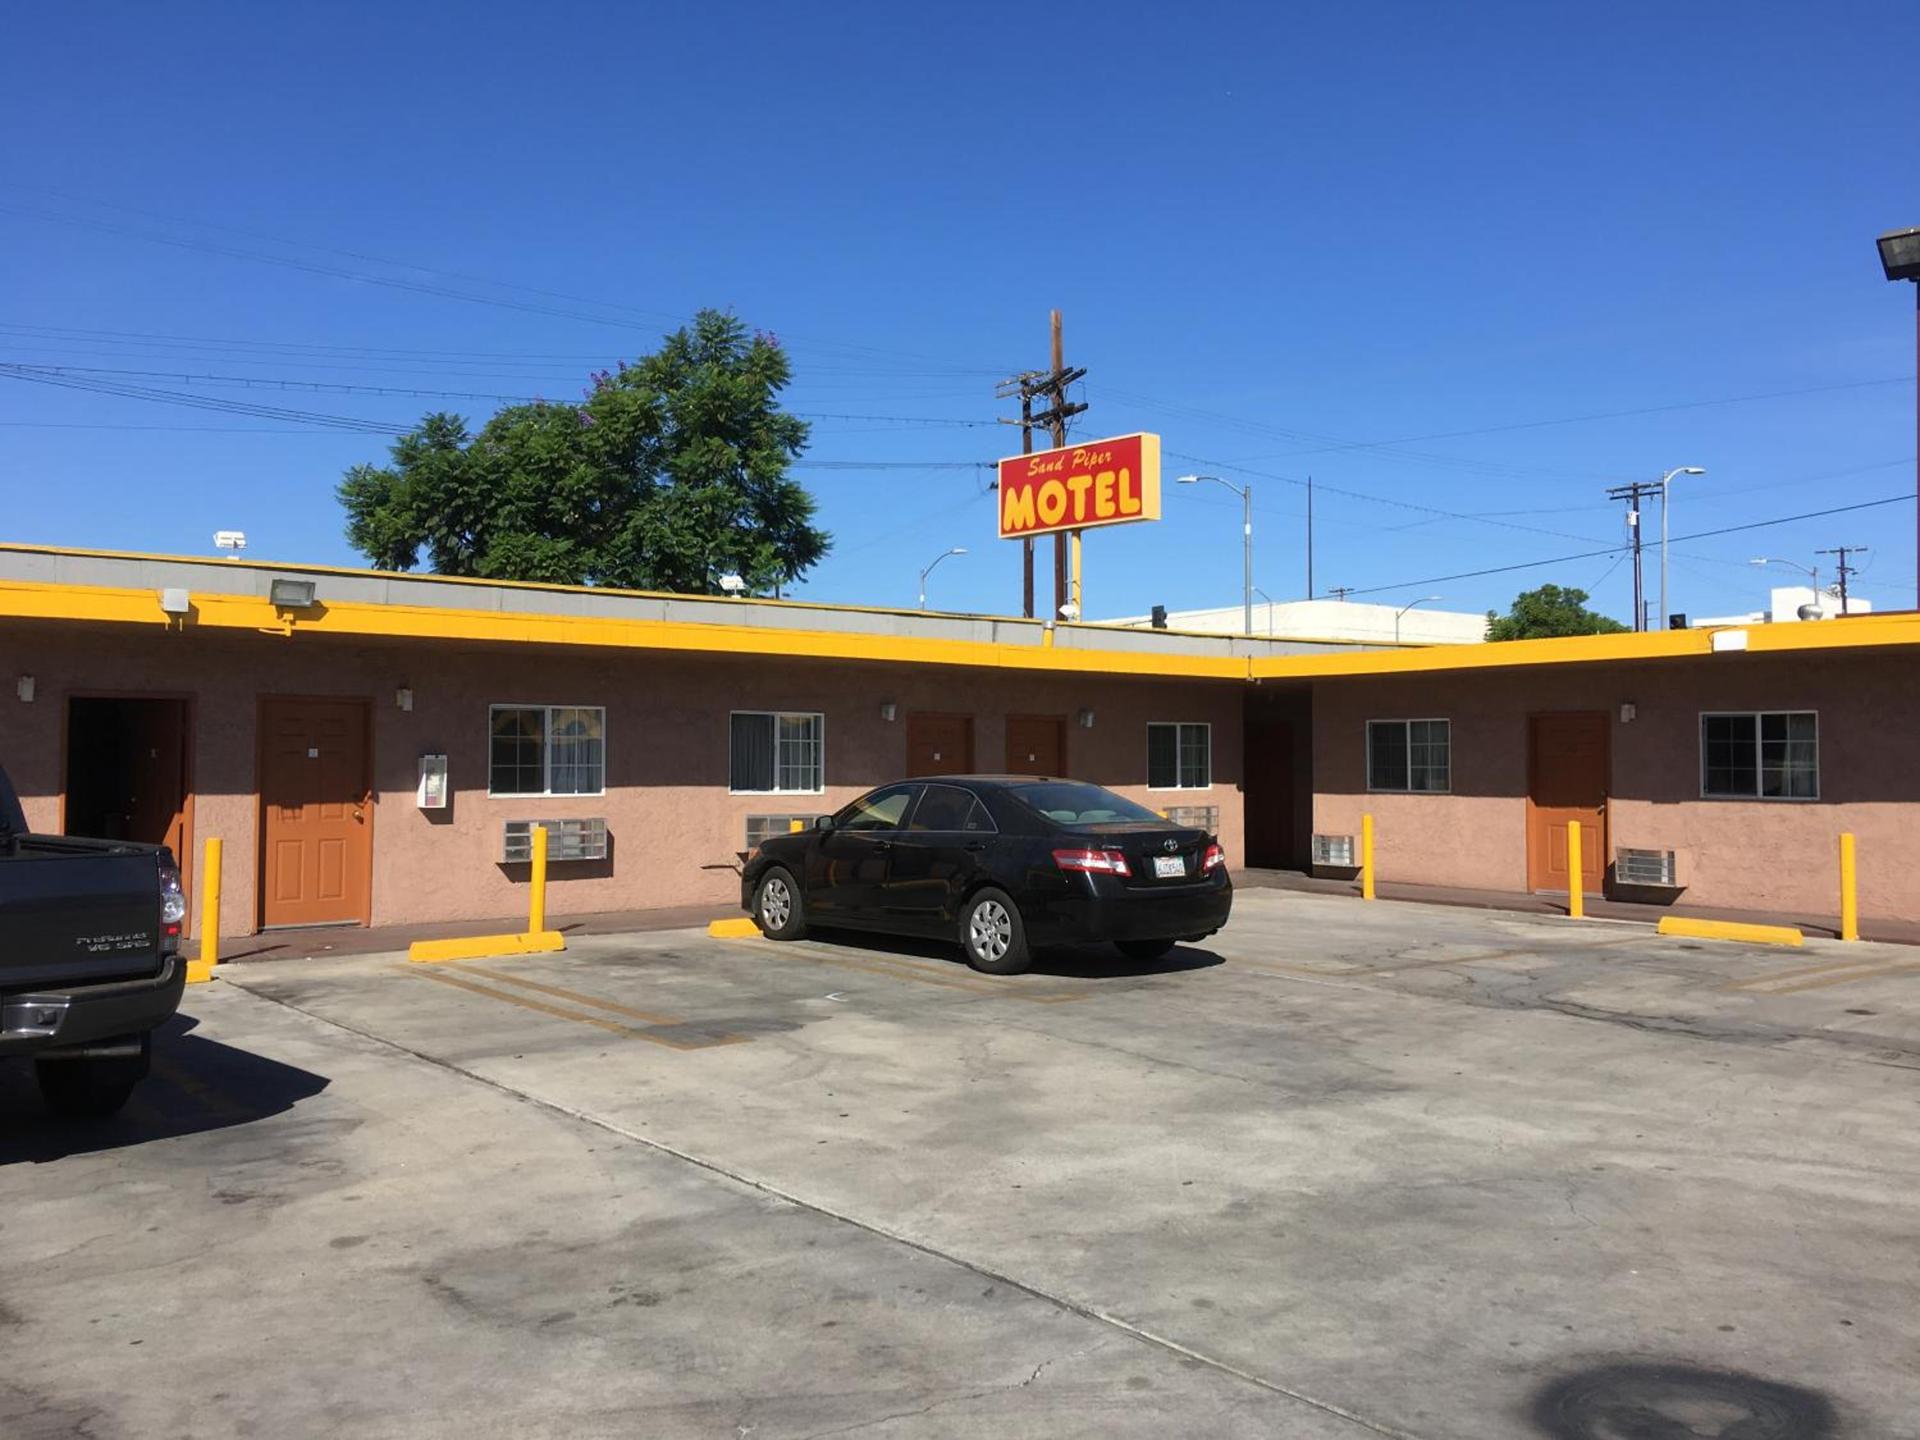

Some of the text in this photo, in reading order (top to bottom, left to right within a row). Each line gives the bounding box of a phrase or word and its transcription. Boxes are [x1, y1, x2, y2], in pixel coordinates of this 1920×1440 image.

[1027, 448, 1113, 477] Sand Piper
[1003, 467, 1141, 532] MOTEL
